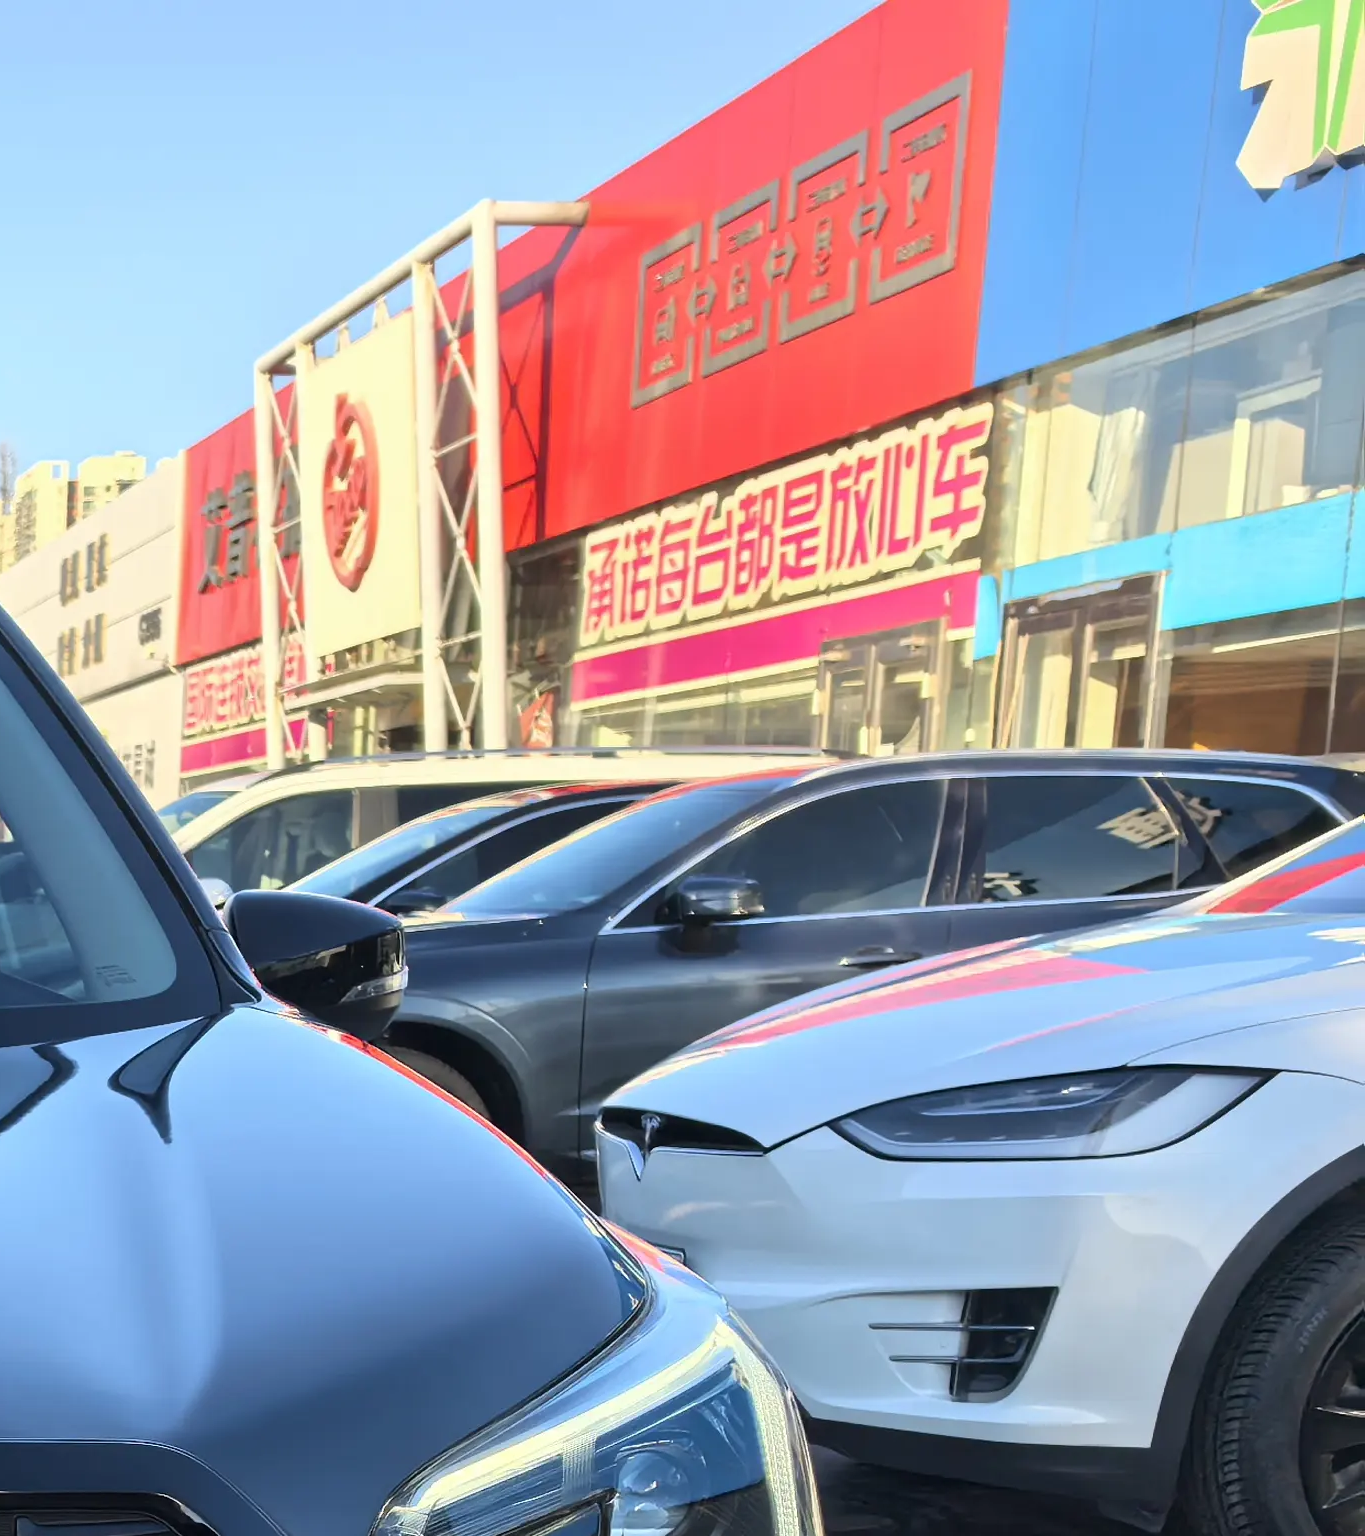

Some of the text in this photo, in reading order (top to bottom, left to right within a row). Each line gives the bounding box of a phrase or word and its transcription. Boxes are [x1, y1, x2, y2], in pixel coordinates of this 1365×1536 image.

[583, 412, 991, 638] 承诺每台都是放心车
